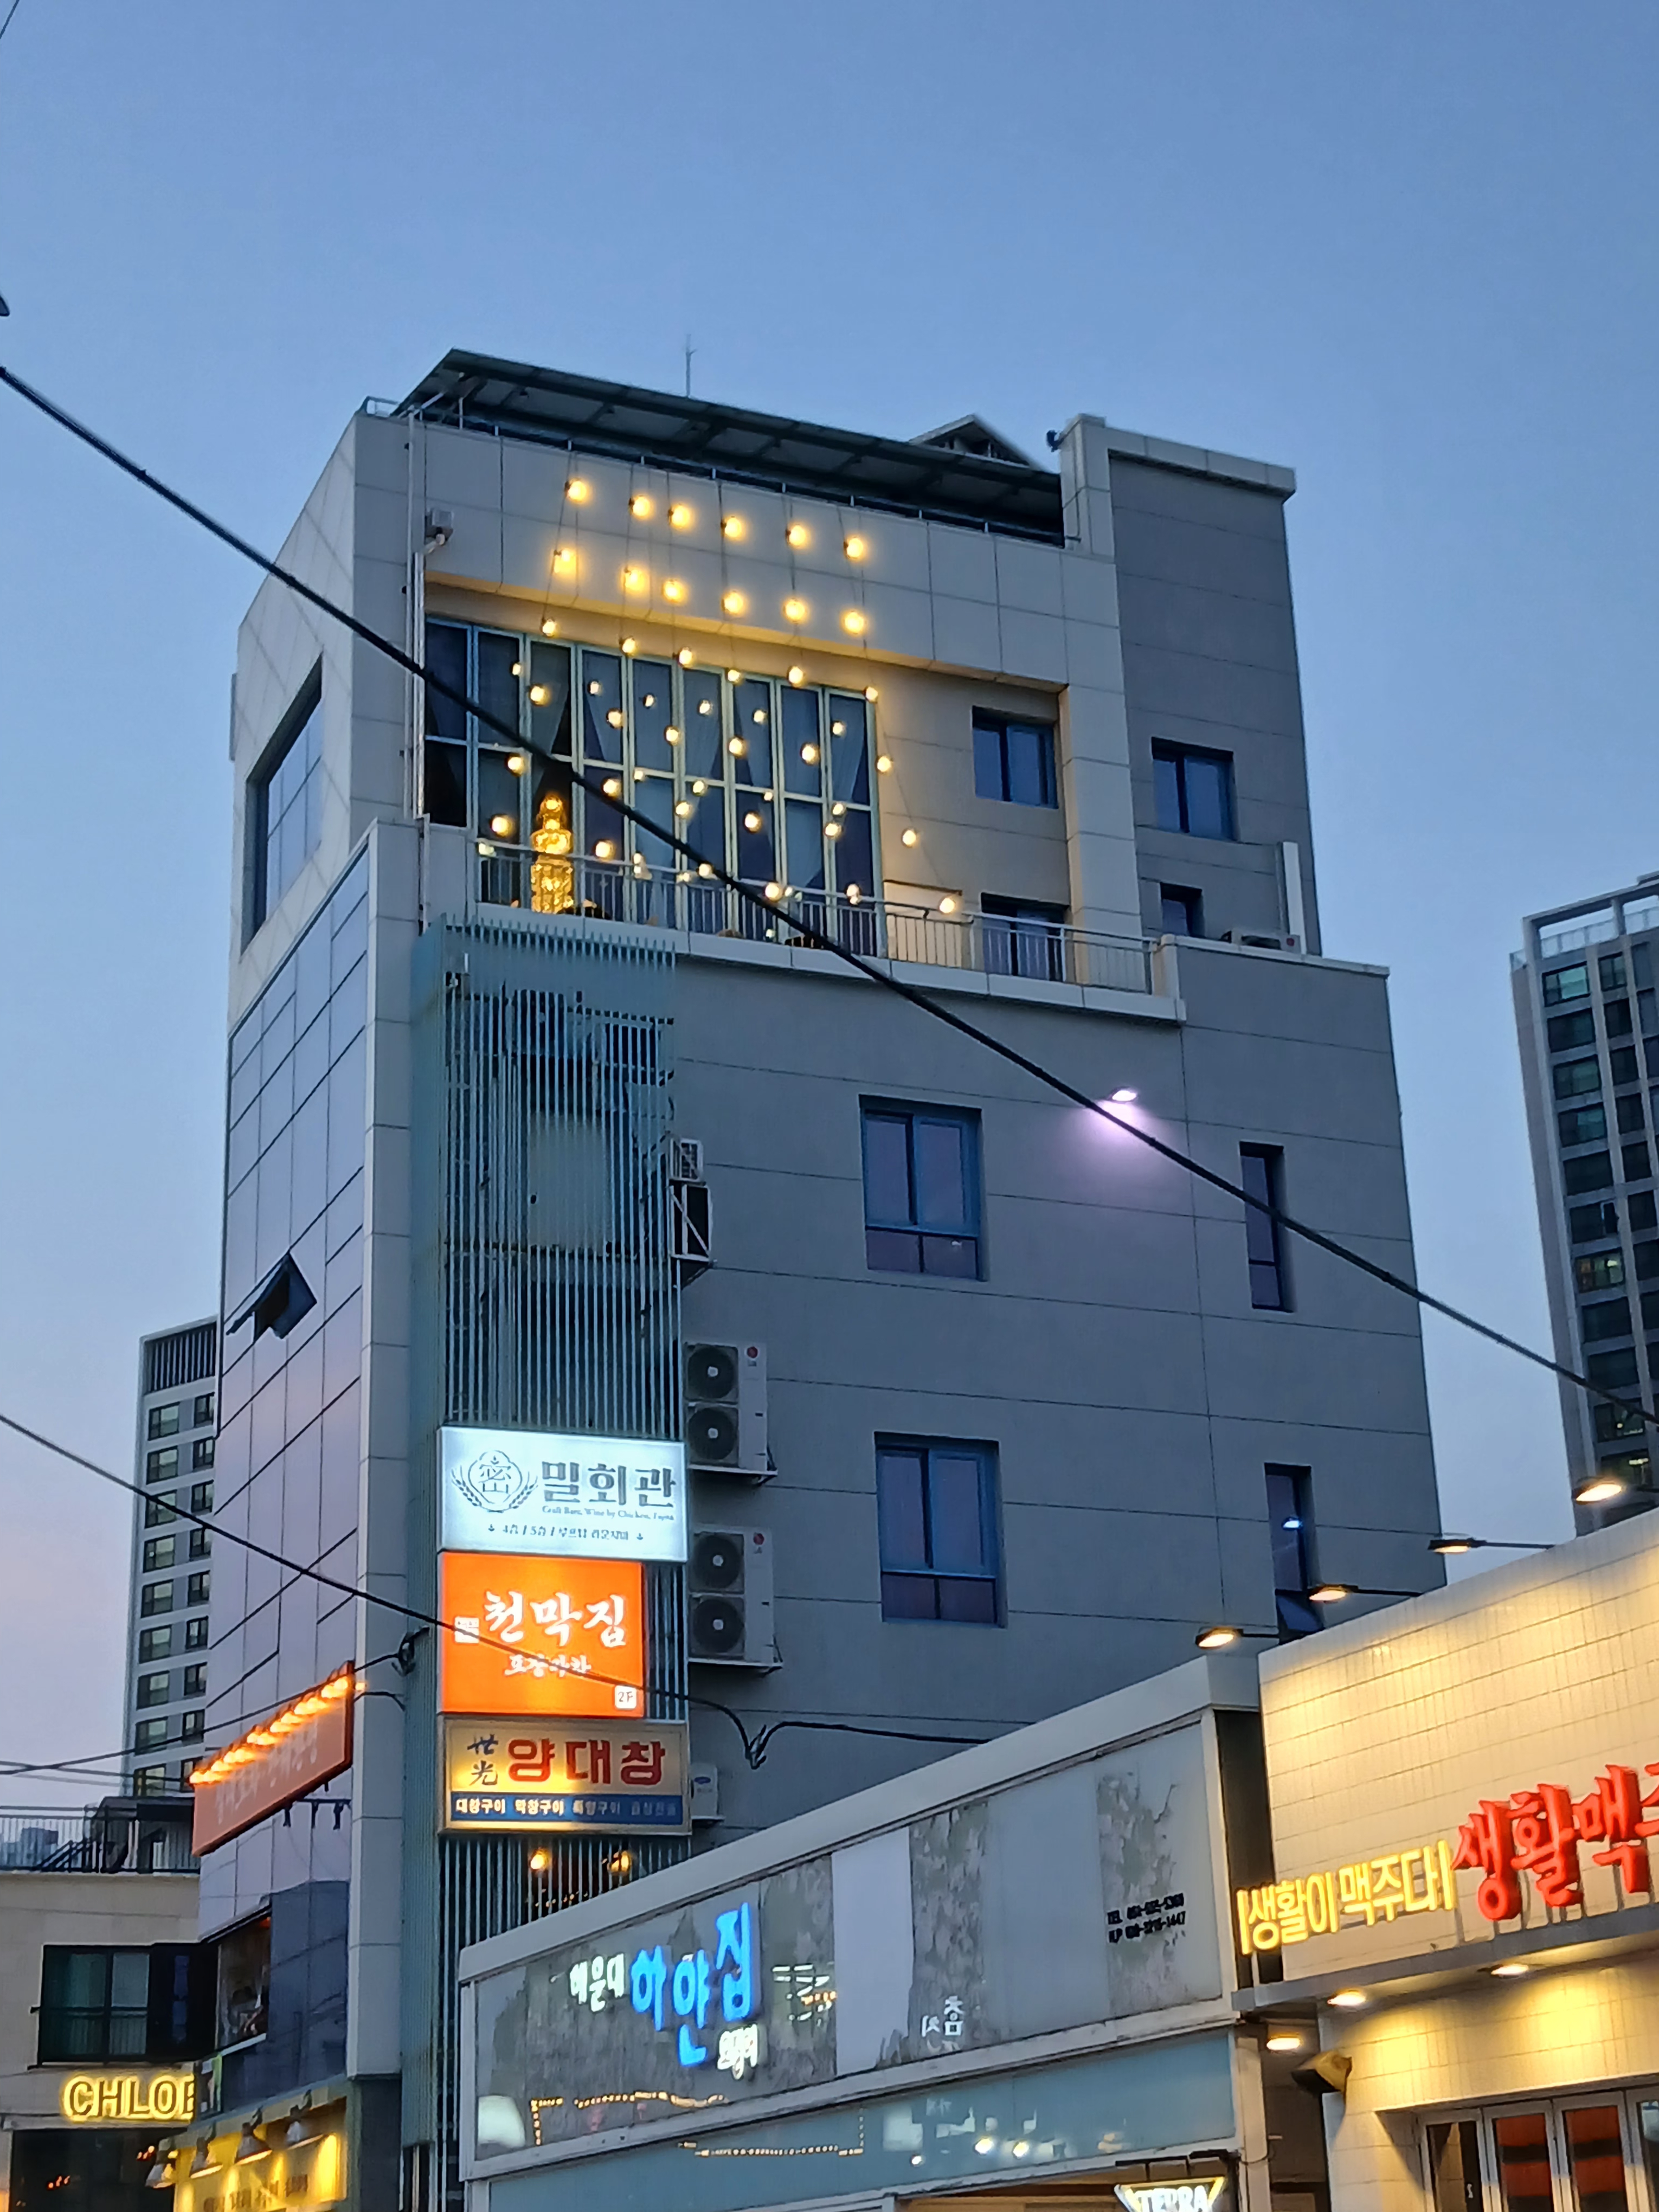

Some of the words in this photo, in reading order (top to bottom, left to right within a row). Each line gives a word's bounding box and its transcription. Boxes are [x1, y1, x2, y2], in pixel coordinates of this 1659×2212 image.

[542, 1461, 676, 1507] 밀회관
[484, 1591, 626, 1648] 천막집
[619, 1691, 633, 1703] 2F
[507, 1738, 665, 1785] 양대창
[455, 1797, 506, 1815] 대창구이
[569, 1953, 624, 2012] 해운대
[631, 1902, 752, 2067] 하얀집
